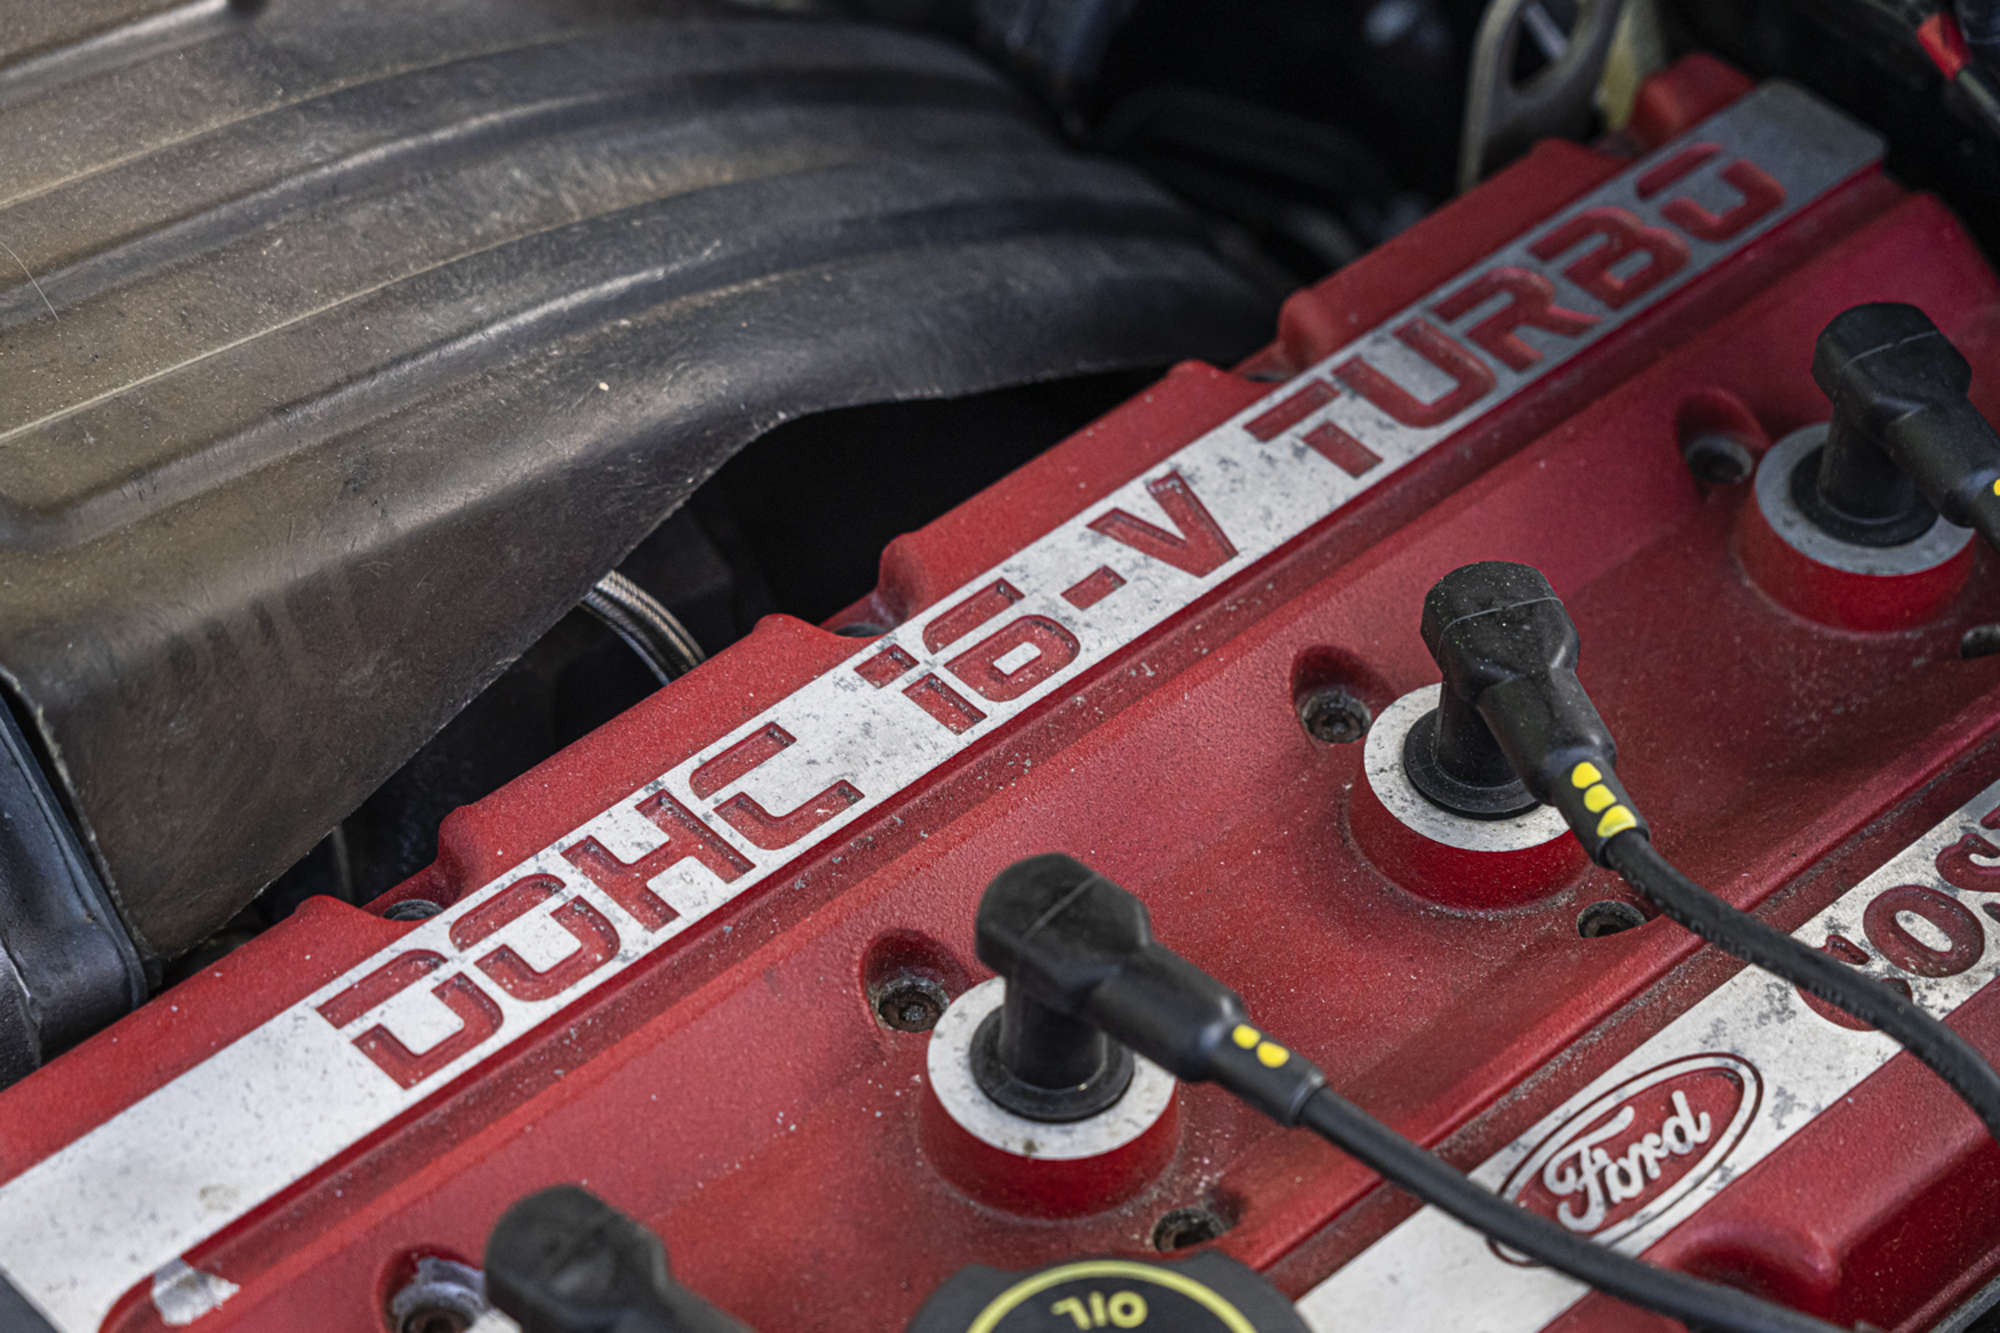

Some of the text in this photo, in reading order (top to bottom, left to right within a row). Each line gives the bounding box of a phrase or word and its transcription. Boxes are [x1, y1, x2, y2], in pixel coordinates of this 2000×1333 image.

[315, 142, 1787, 1090] DOHC 16-V TURBO
[1543, 1090, 1712, 1233] Ford
[1050, 1290, 1149, 1331] OIL
